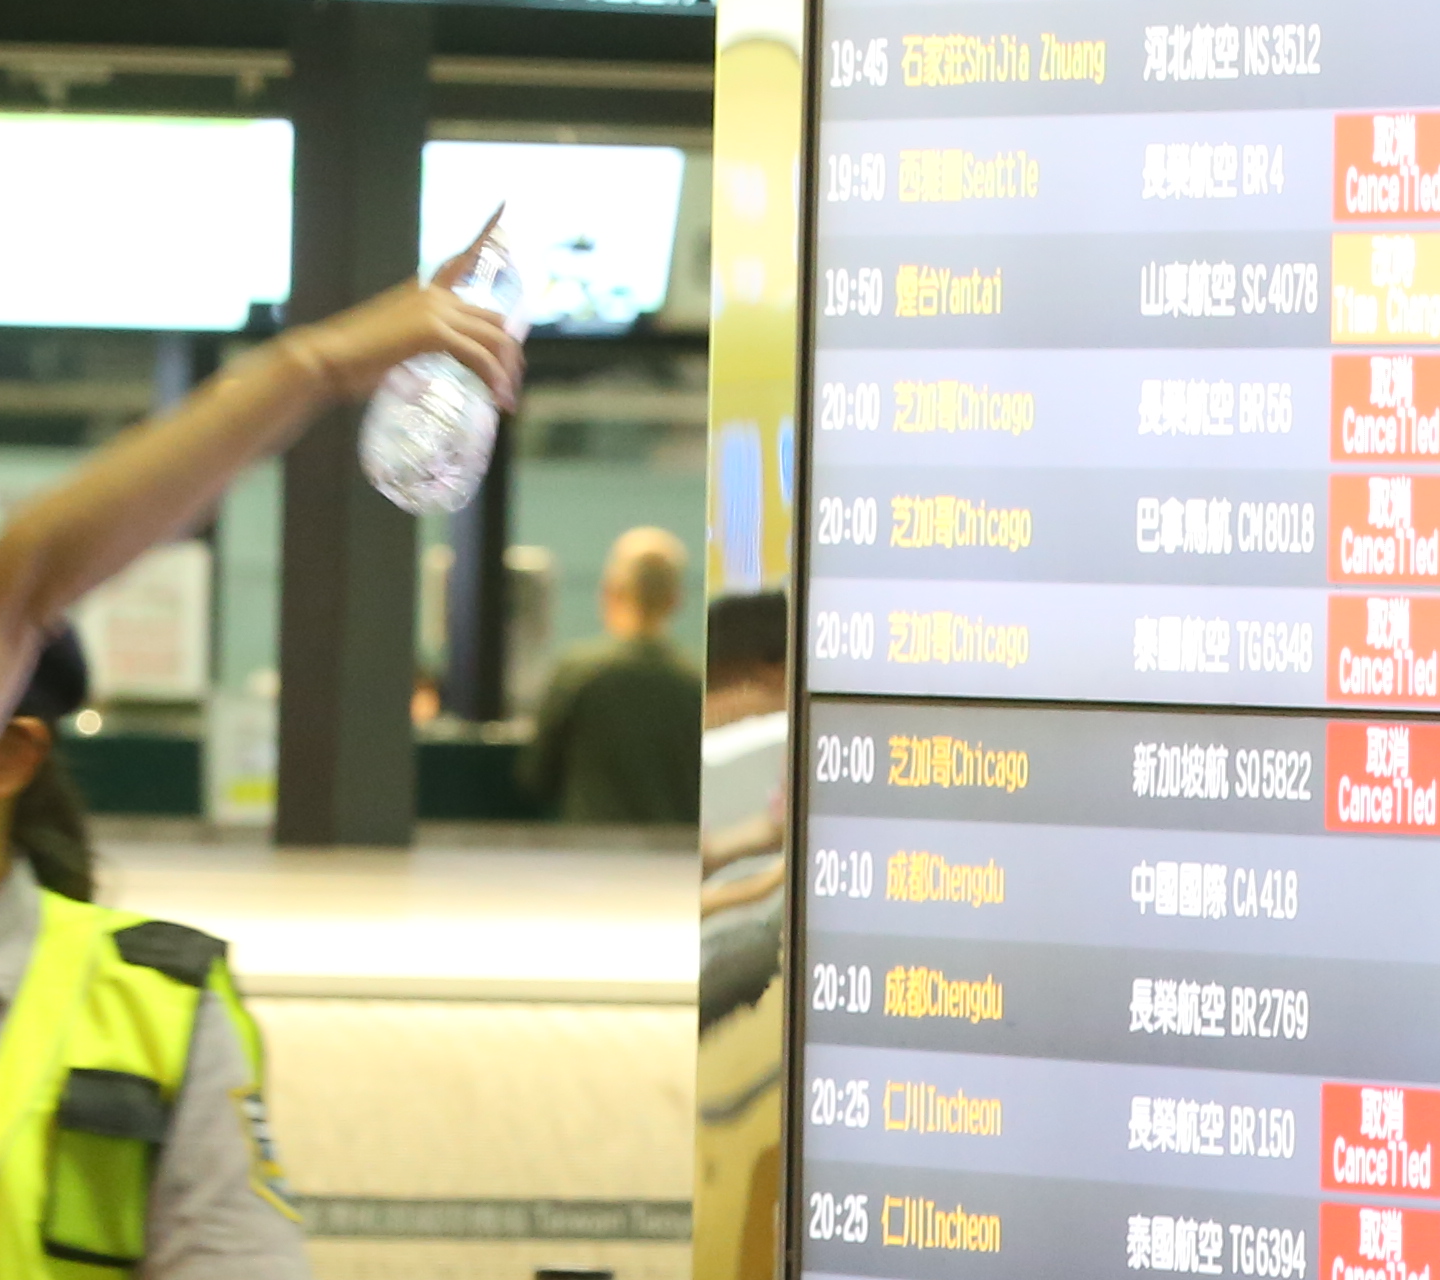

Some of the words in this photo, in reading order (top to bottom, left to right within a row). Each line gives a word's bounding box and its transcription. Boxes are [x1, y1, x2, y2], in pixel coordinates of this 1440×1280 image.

[830, 37, 889, 87] 19:45
[824, 267, 883, 316] 19:50
[817, 735, 875, 783] 20:00
[1133, 742, 1229, 799] 新加坡航
[1365, 726, 1409, 777] 取消
[1338, 775, 1437, 820] Cancelled
[813, 963, 871, 1013] 20:10
[1129, 978, 1226, 1036] 長榮航空
[811, 1078, 870, 1128] 20:25
[1128, 1096, 1225, 1155] 長榮航空
[1360, 1088, 1404, 1140] 取消
[1333, 1136, 1432, 1189] Cancelled
